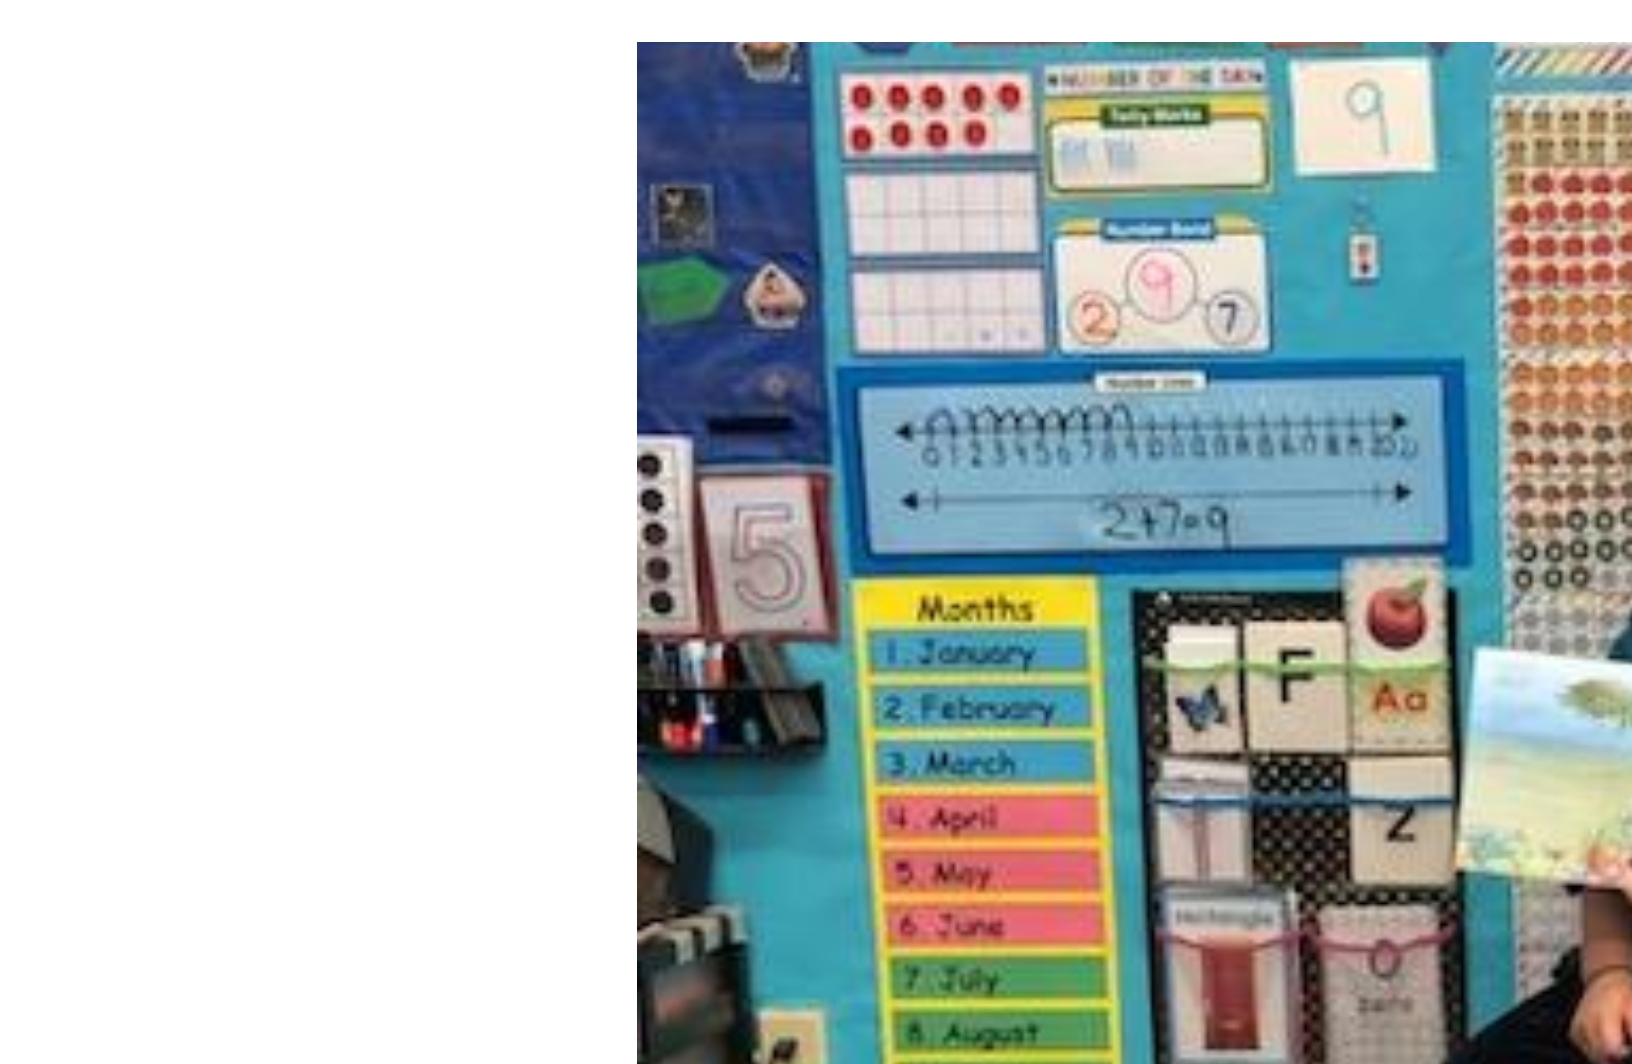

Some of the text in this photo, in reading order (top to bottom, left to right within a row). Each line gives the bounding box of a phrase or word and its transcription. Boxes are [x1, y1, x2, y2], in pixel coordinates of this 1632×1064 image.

[1345, 80, 1389, 157] 9
[1141, 259, 1175, 316] 9
[1081, 299, 1119, 338] 2
[1216, 301, 1240, 336] 7
[731, 503, 807, 614] 5
[917, 596, 1035, 622] Months
[916, 639, 1037, 672] January
[1278, 649, 1313, 704] F
[920, 694, 1057, 725] February
[1371, 682, 1429, 713] Aa
[925, 750, 1017, 773] March
[928, 805, 1000, 835] April
[931, 859, 993, 890] May
[936, 914, 1005, 935] June
[940, 966, 1001, 994] July
[943, 1021, 1041, 1051] August
